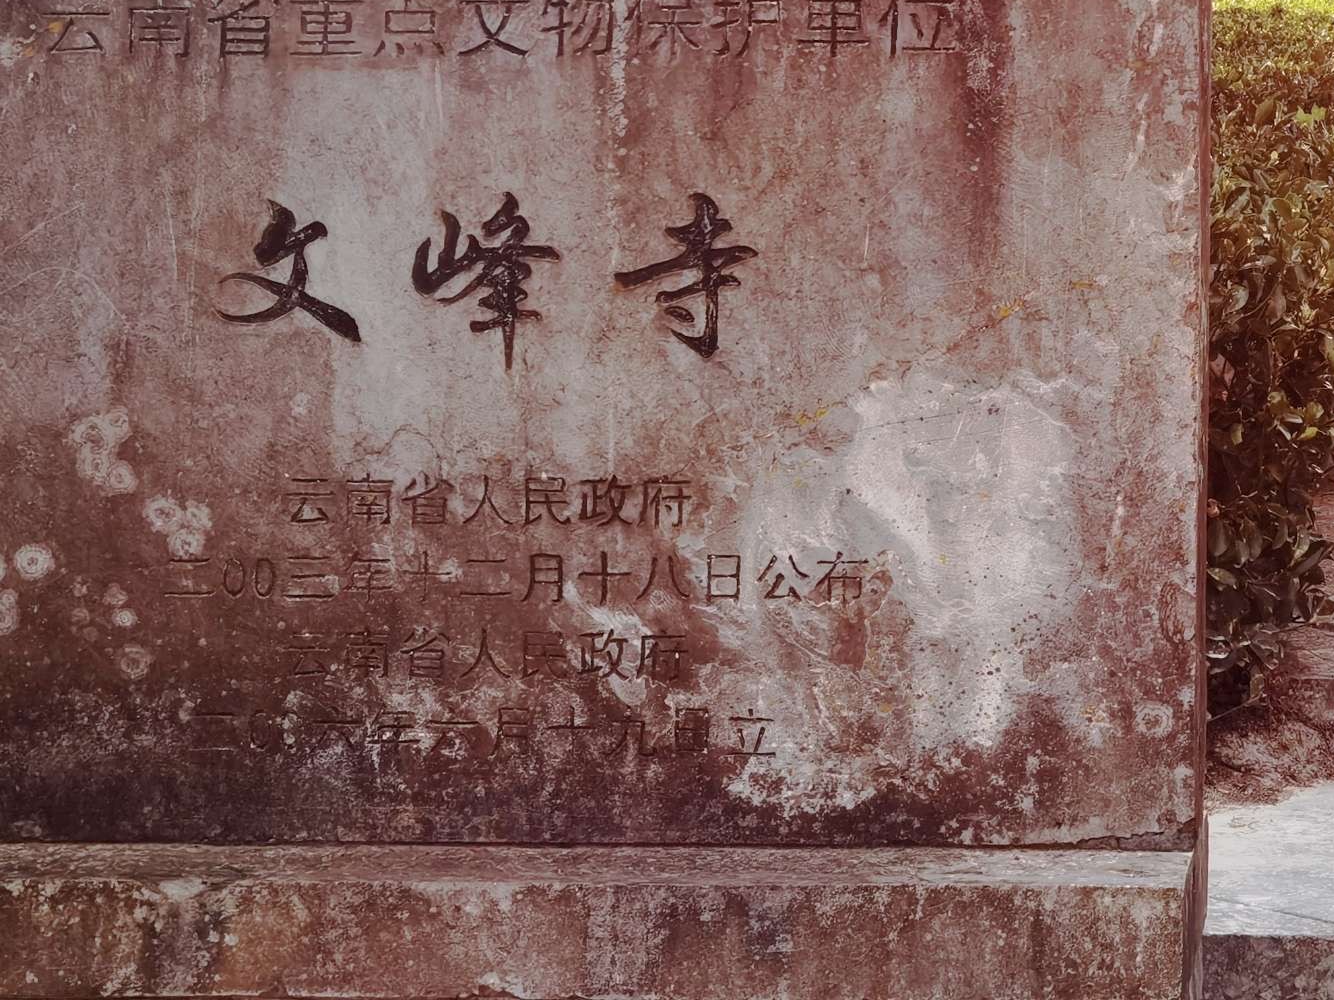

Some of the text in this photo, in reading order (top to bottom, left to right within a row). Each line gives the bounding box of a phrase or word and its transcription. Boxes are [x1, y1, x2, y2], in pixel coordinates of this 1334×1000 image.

[213, 191, 758, 371] 文峰寺
[285, 472, 692, 529] 云南省人民政府
[284, 627, 689, 682] 云南省人民政府
